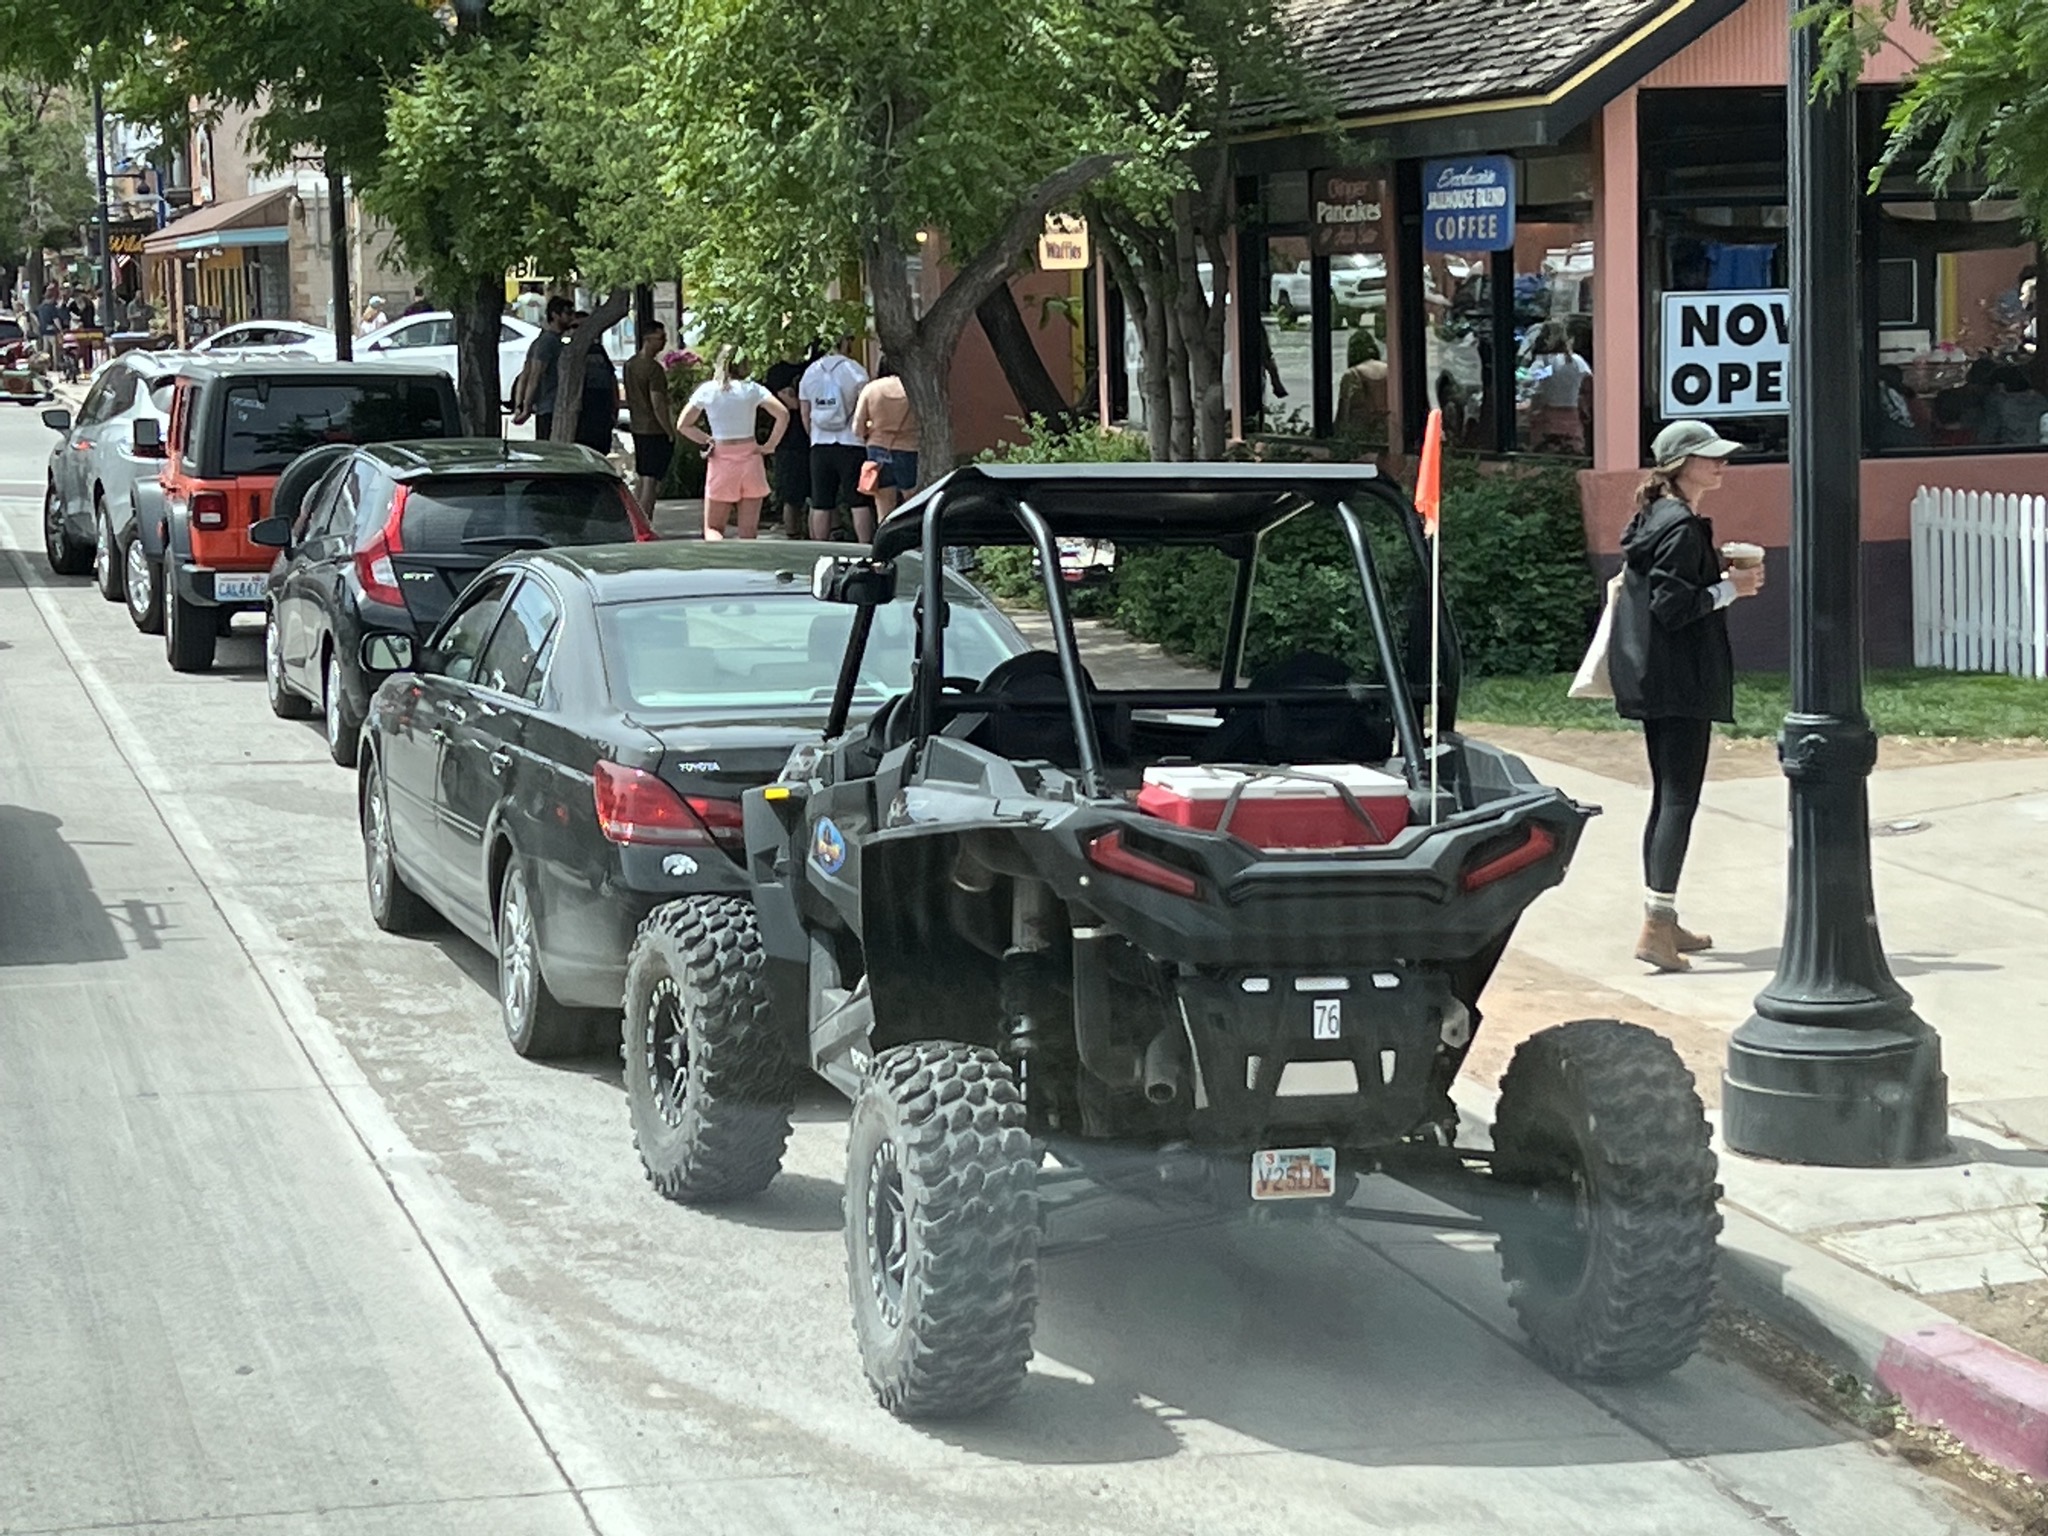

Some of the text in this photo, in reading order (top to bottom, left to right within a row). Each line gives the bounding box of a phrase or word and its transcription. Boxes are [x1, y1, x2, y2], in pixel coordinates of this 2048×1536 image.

[1317, 200, 1382, 225] Pancakes
[1435, 214, 1498, 241] COFFEE
[1671, 361, 1791, 406] OPE
[678, 762, 720, 772] TOYOTA
[1315, 1004, 1339, 1036] 76
